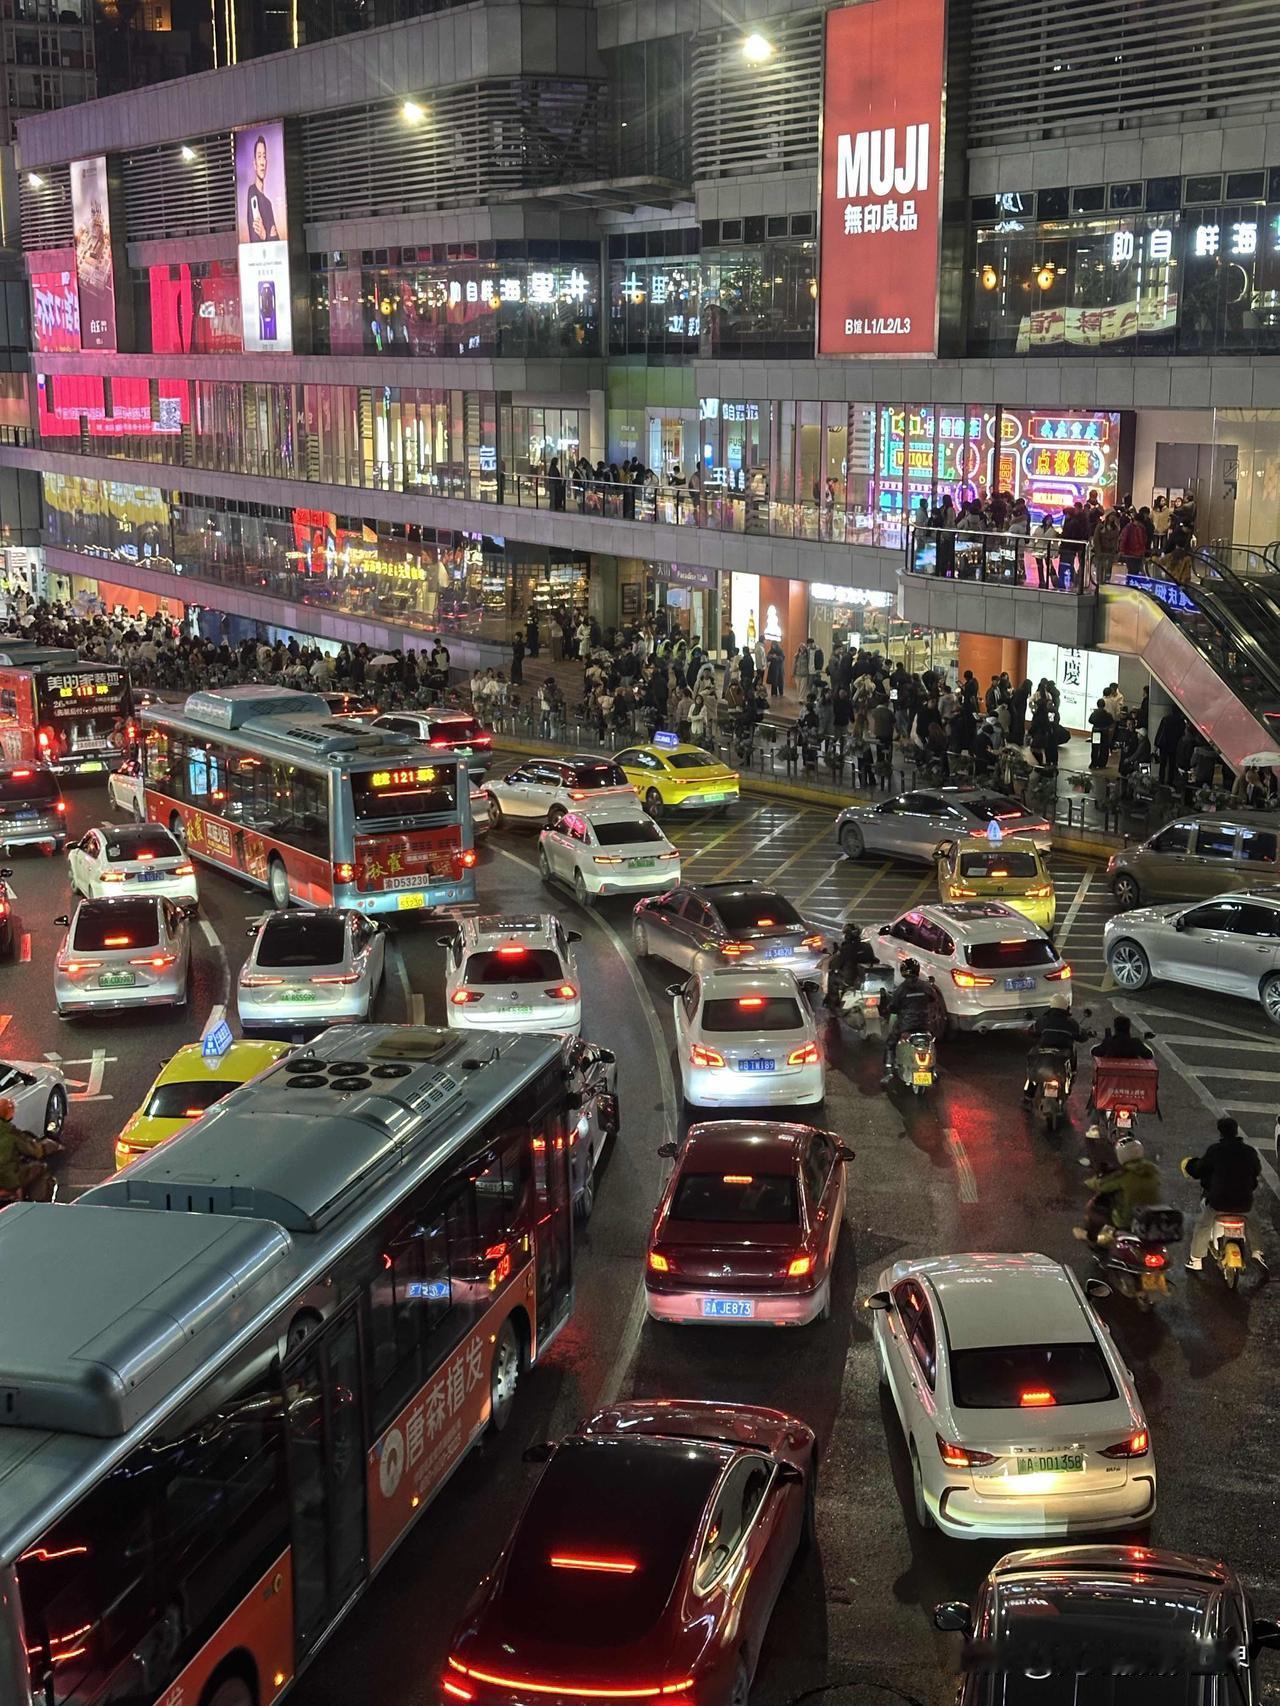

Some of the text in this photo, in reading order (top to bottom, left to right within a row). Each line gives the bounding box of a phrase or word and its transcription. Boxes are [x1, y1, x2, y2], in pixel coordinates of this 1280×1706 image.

[837, 124, 930, 199] MUJI
[844, 199, 918, 235] 無印良品
[845, 317, 911, 335] B馆 L1/L2/L3
[1036, 448, 1090, 477] 点都德
[677, 570, 697, 581] Paradise
[393, 771, 414, 784] 121
[385, 875, 428, 890] 渝D53230
